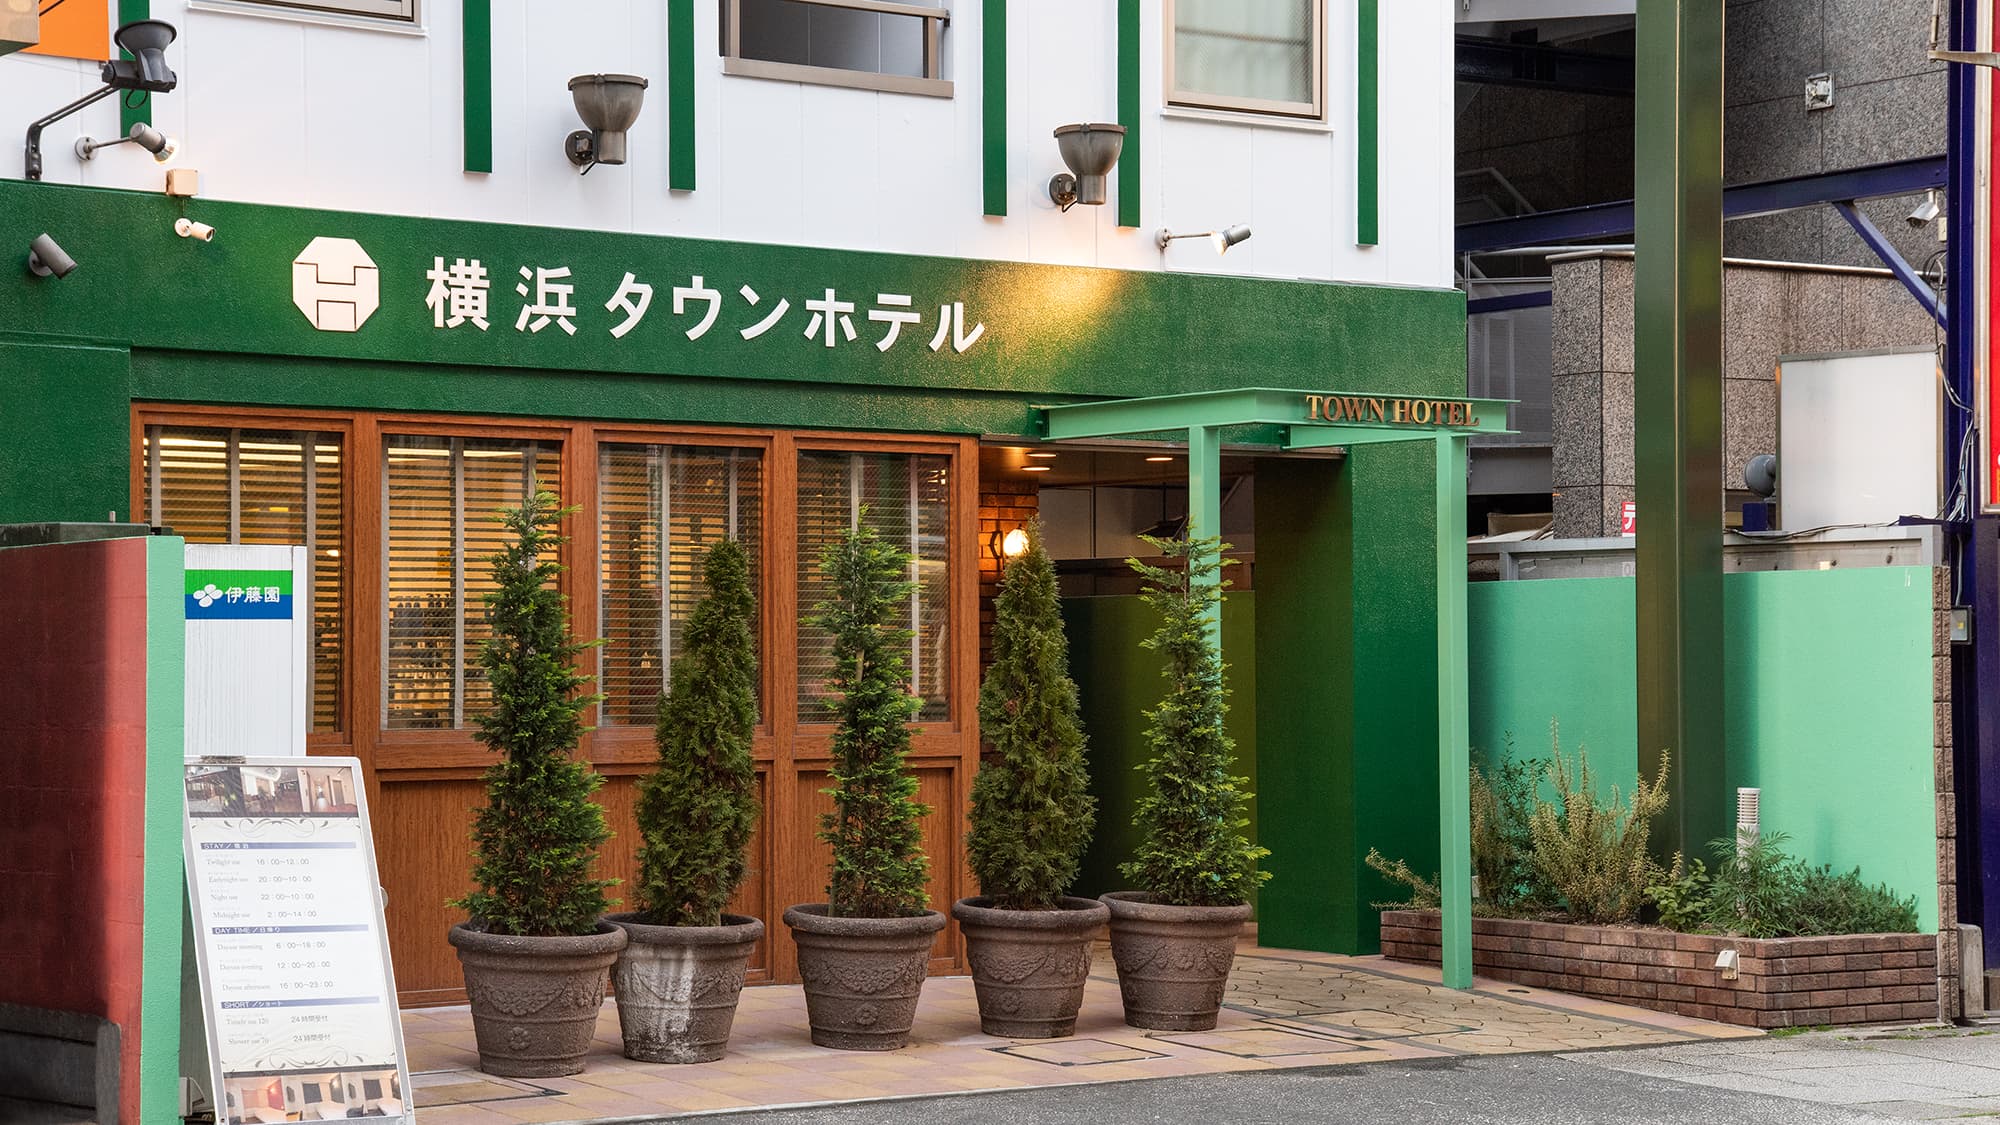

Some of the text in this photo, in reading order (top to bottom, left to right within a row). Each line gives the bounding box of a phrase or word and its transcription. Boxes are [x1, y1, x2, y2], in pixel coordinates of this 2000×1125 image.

[1306, 394, 1480, 427] TOWN HOTEL
[225, 586, 280, 604] 伊藤園
